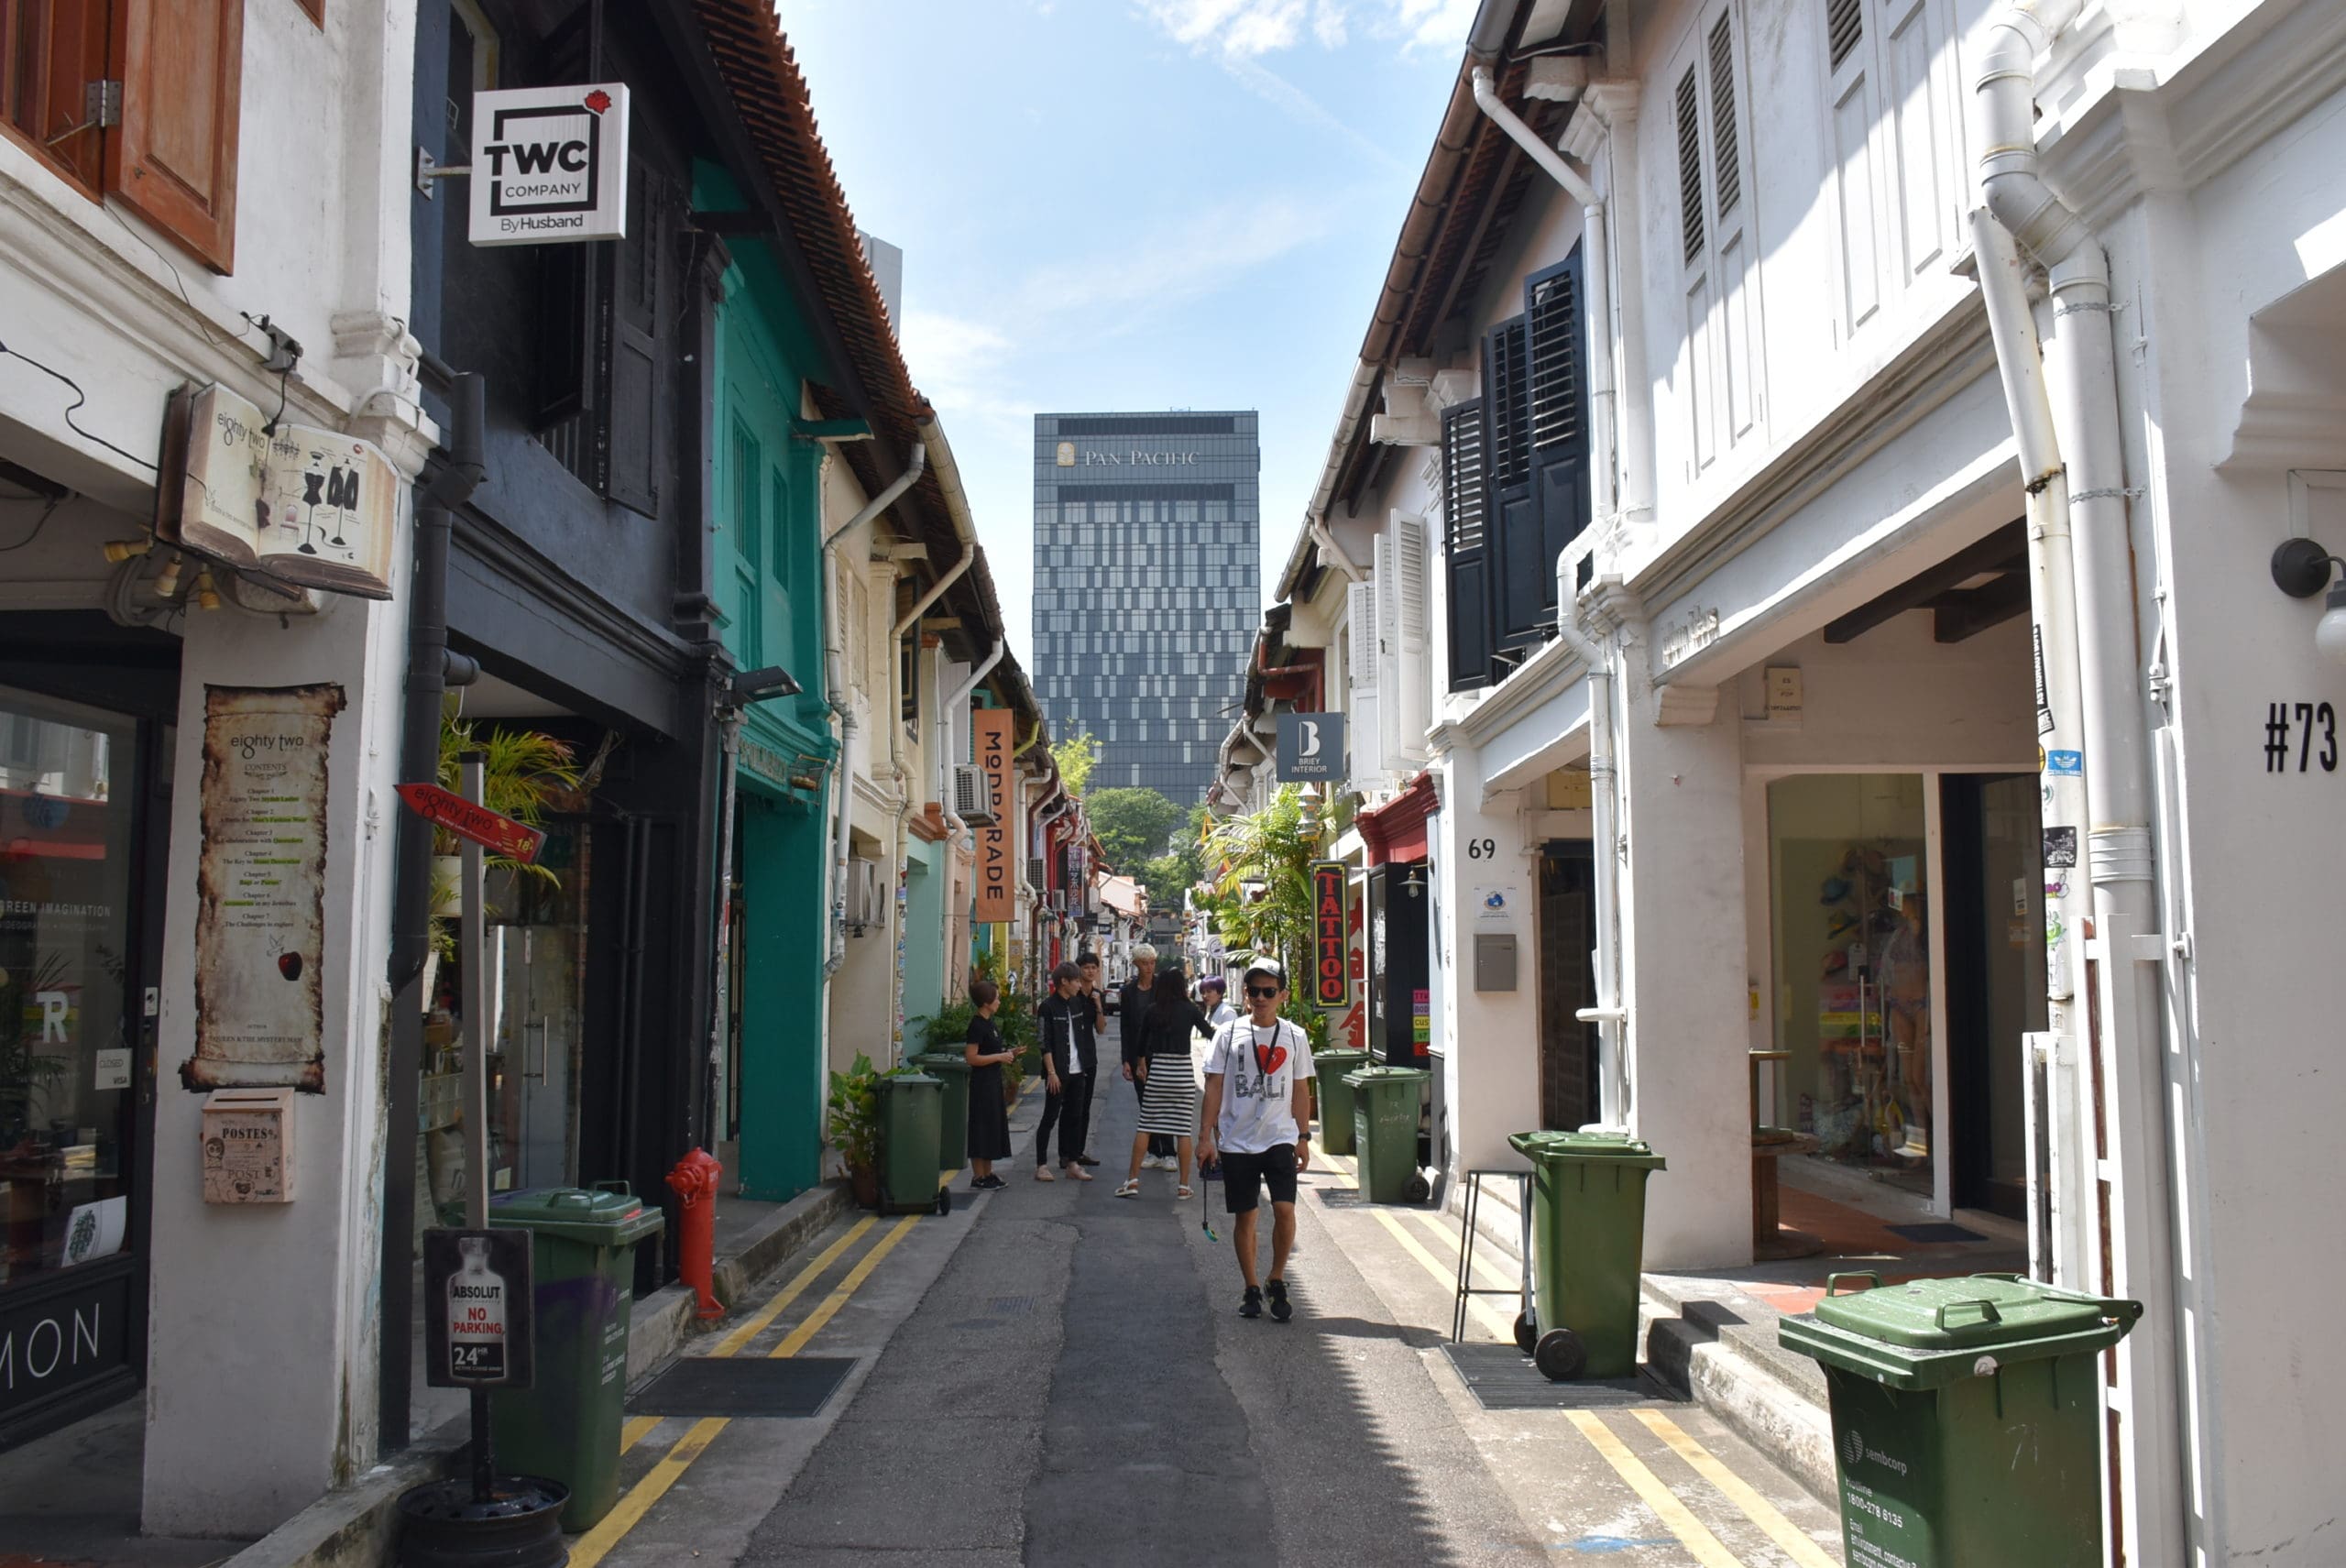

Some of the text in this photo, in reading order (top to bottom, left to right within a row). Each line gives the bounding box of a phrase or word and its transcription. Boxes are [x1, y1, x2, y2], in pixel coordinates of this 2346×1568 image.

[484, 140, 587, 176] TWC
[505, 183, 581, 198] COMPANY
[501, 214, 583, 233] By Husband
[217, 411, 265, 449] eighty two
[1085, 450, 1200, 466] PAN PACIFIC
[231, 734, 304, 760] eighty two
[2264, 701, 2337, 773] #73
[1291, 765, 1327, 773] INTERIOR
[413, 787, 462, 820] eighty
[1468, 839, 1496, 859] 69
[40, 903, 111, 917] IMAGINATION
[1314, 872, 1343, 998] TATTOO
[222, 1127, 268, 1139] POSTES
[453, 1286, 500, 1299] ABSOLUT
[467, 1307, 487, 1321] NO
[453, 1321, 502, 1334] PARKING
[1865, 1447, 1908, 1476] sembcorp
[1845, 1474, 1873, 1497] Hotline
[1847, 1492, 1903, 1528] 1800-278 6135
